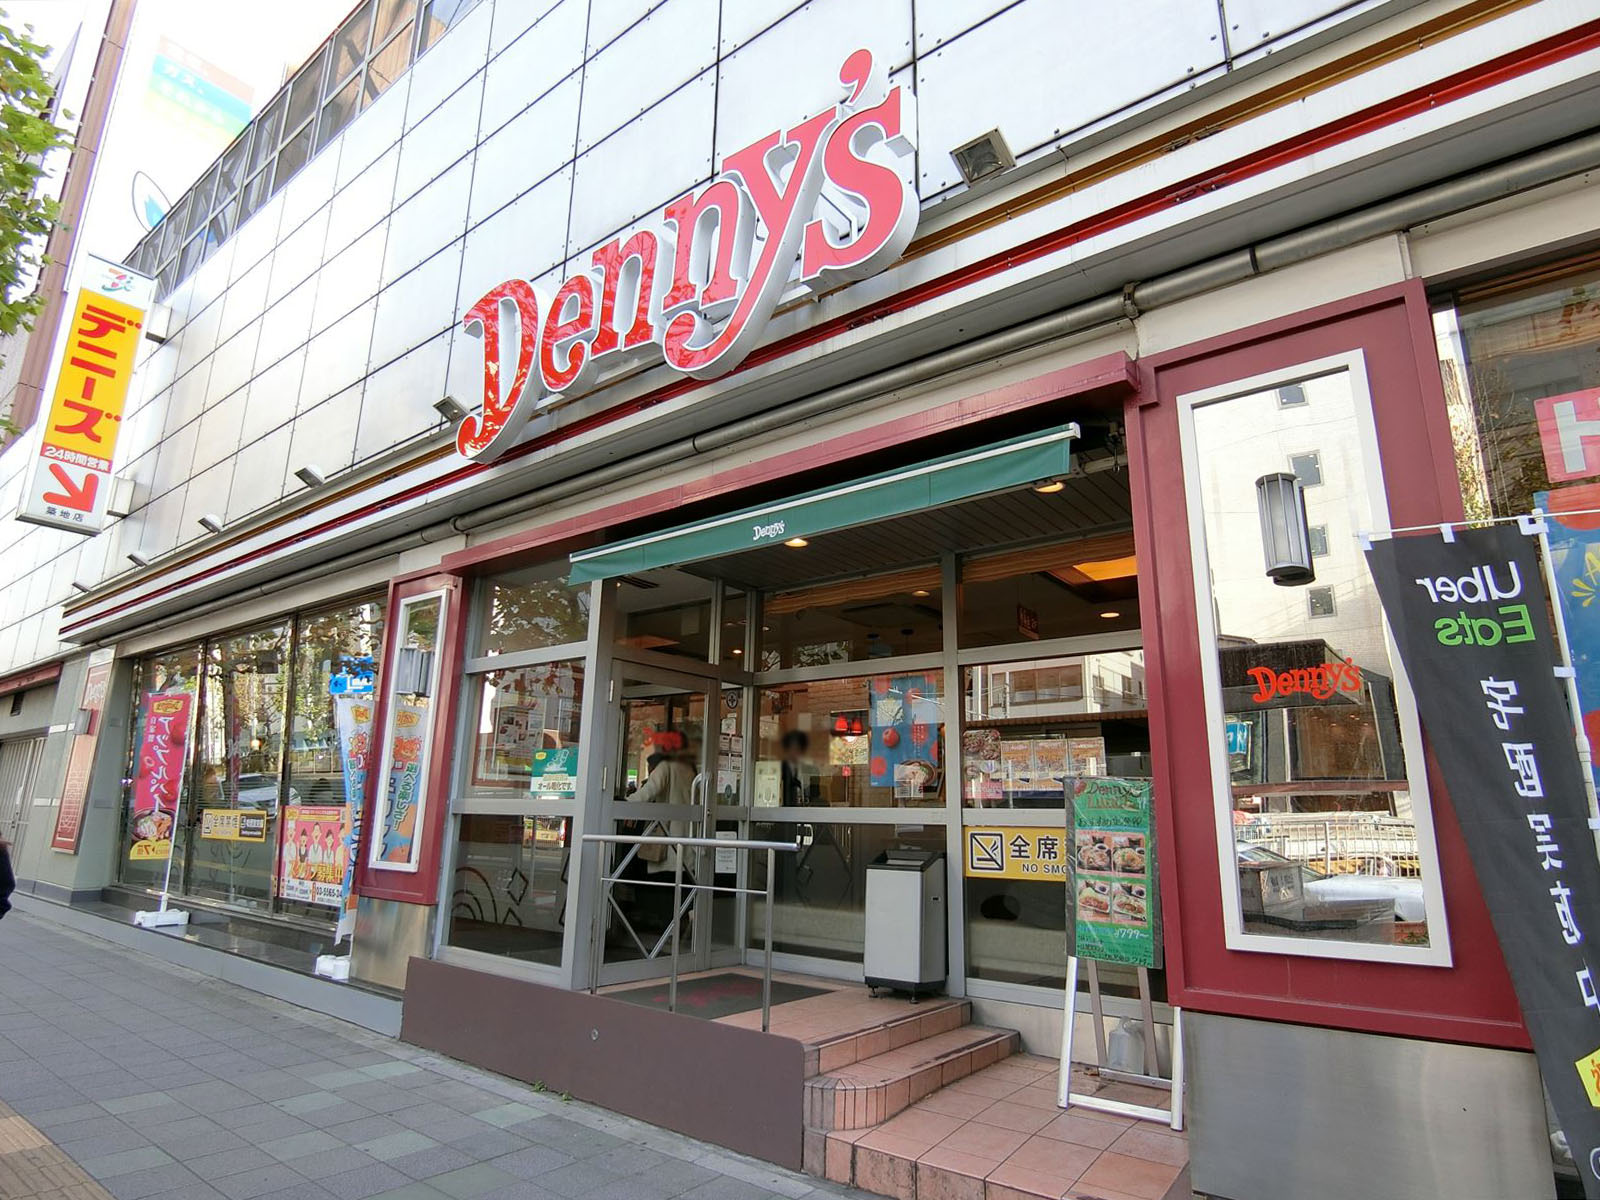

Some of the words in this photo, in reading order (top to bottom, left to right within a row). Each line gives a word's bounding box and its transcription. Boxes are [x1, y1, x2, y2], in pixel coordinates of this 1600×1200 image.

[456, 48, 910, 462] Denny's
[55, 303, 142, 444] デニーズ
[44, 446, 110, 471] 24時間営業
[46, 506, 84, 522] 築地店
[752, 520, 785, 541] Denny's
[1247, 657, 1362, 704] Denny's
[1022, 863, 1038, 872] NO
